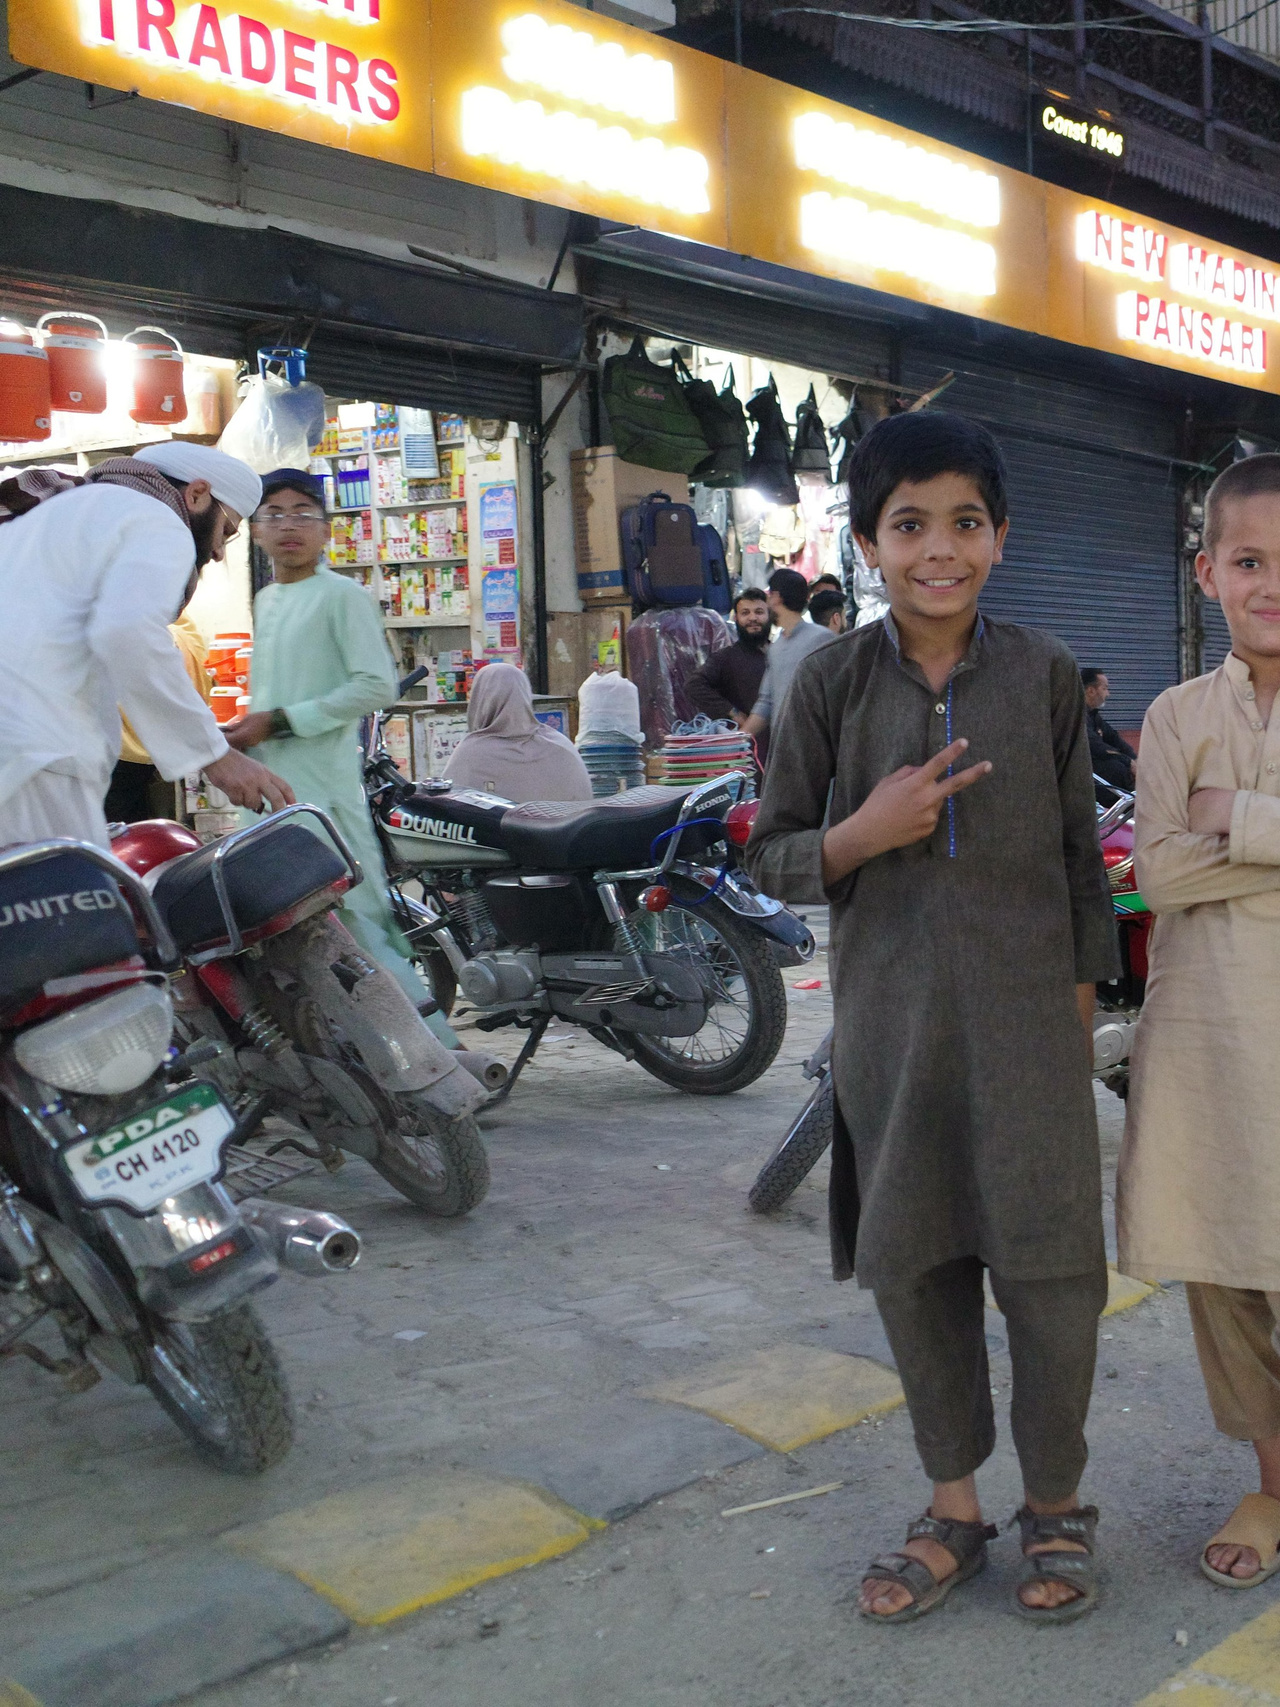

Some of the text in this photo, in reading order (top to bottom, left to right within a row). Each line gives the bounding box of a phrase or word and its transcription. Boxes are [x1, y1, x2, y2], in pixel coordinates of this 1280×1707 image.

[1042, 106, 1123, 157] Const 1946
[1092, 211, 1168, 281] NEW
[1134, 292, 1267, 372] PANSARI
[400, 812, 478, 844] DUNHILL
[694, 793, 731, 814] HONDA
[115, 1128, 200, 1181] CH 4120
